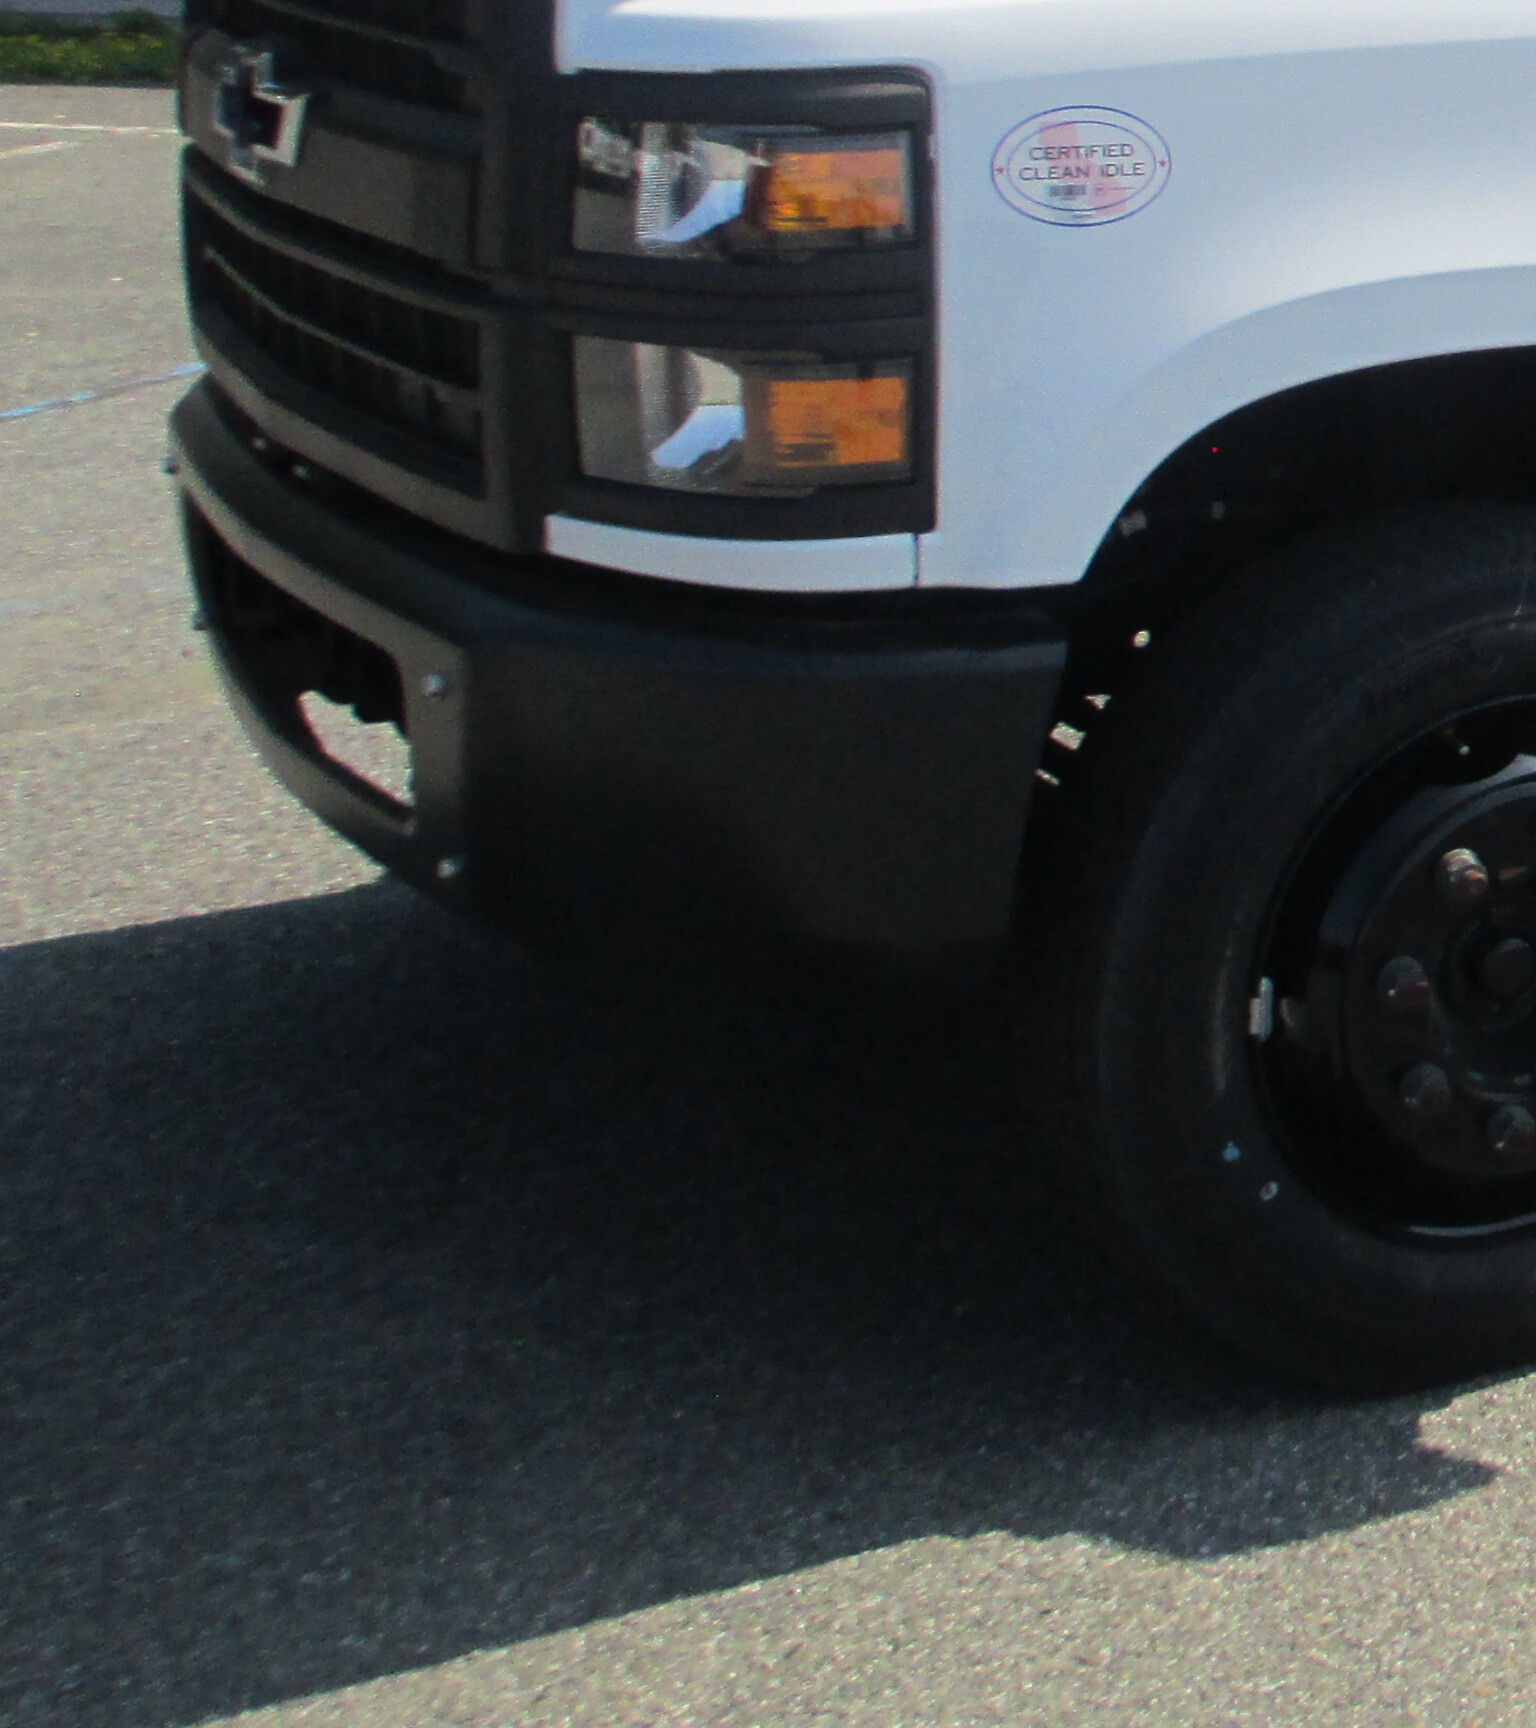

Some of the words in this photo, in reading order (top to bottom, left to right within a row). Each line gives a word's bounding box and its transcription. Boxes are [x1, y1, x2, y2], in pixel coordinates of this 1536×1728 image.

[1028, 143, 1135, 161] CERTIFIED
[1018, 165, 1089, 181] CLEAN
[1101, 162, 1146, 178] IDLE
